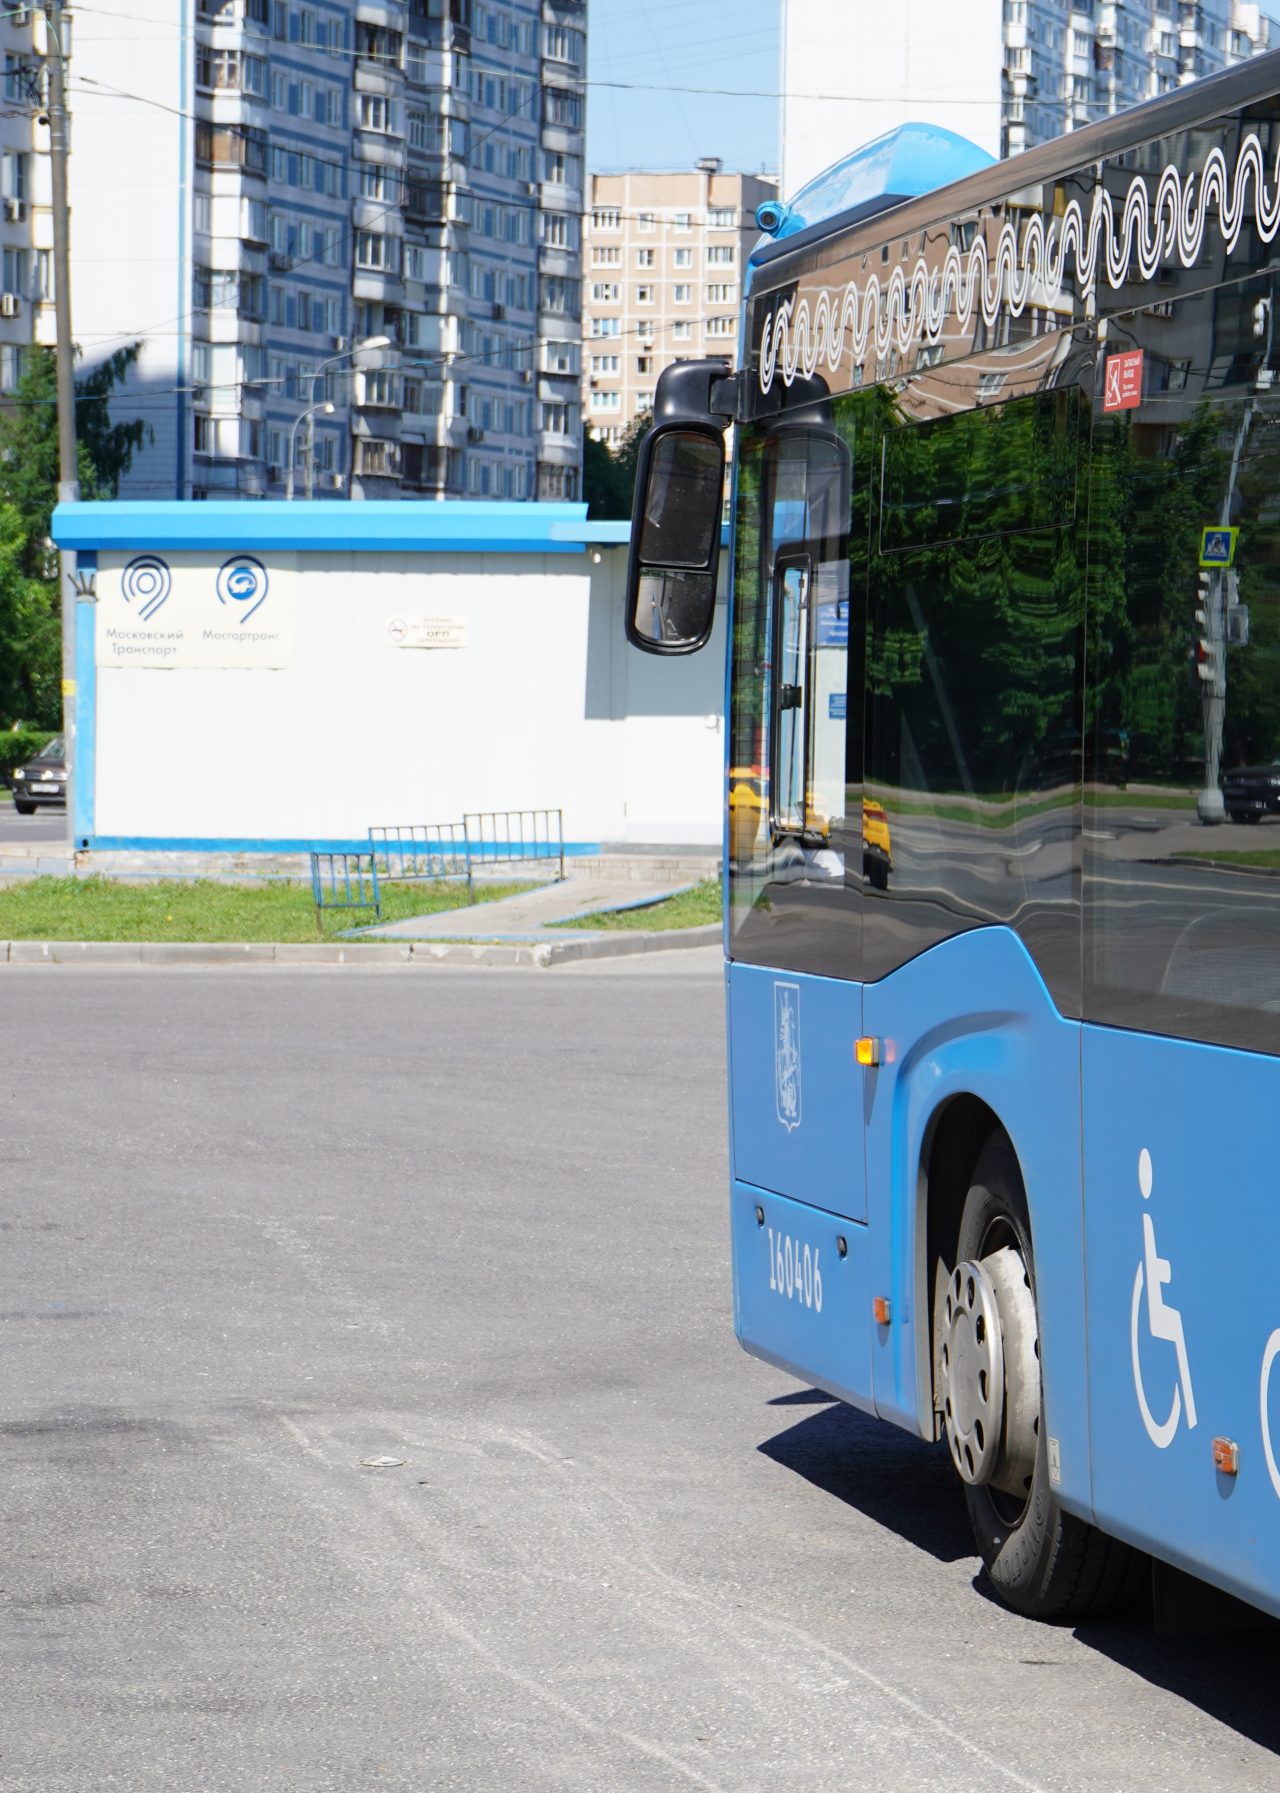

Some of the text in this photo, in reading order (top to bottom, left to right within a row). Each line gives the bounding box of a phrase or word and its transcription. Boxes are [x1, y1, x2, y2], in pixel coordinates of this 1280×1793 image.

[106, 628, 184, 640] Московский
[202, 629, 280, 642] Мосгортранс
[112, 643, 177, 657] Транспорт
[768, 1228, 823, 1313] 160406
